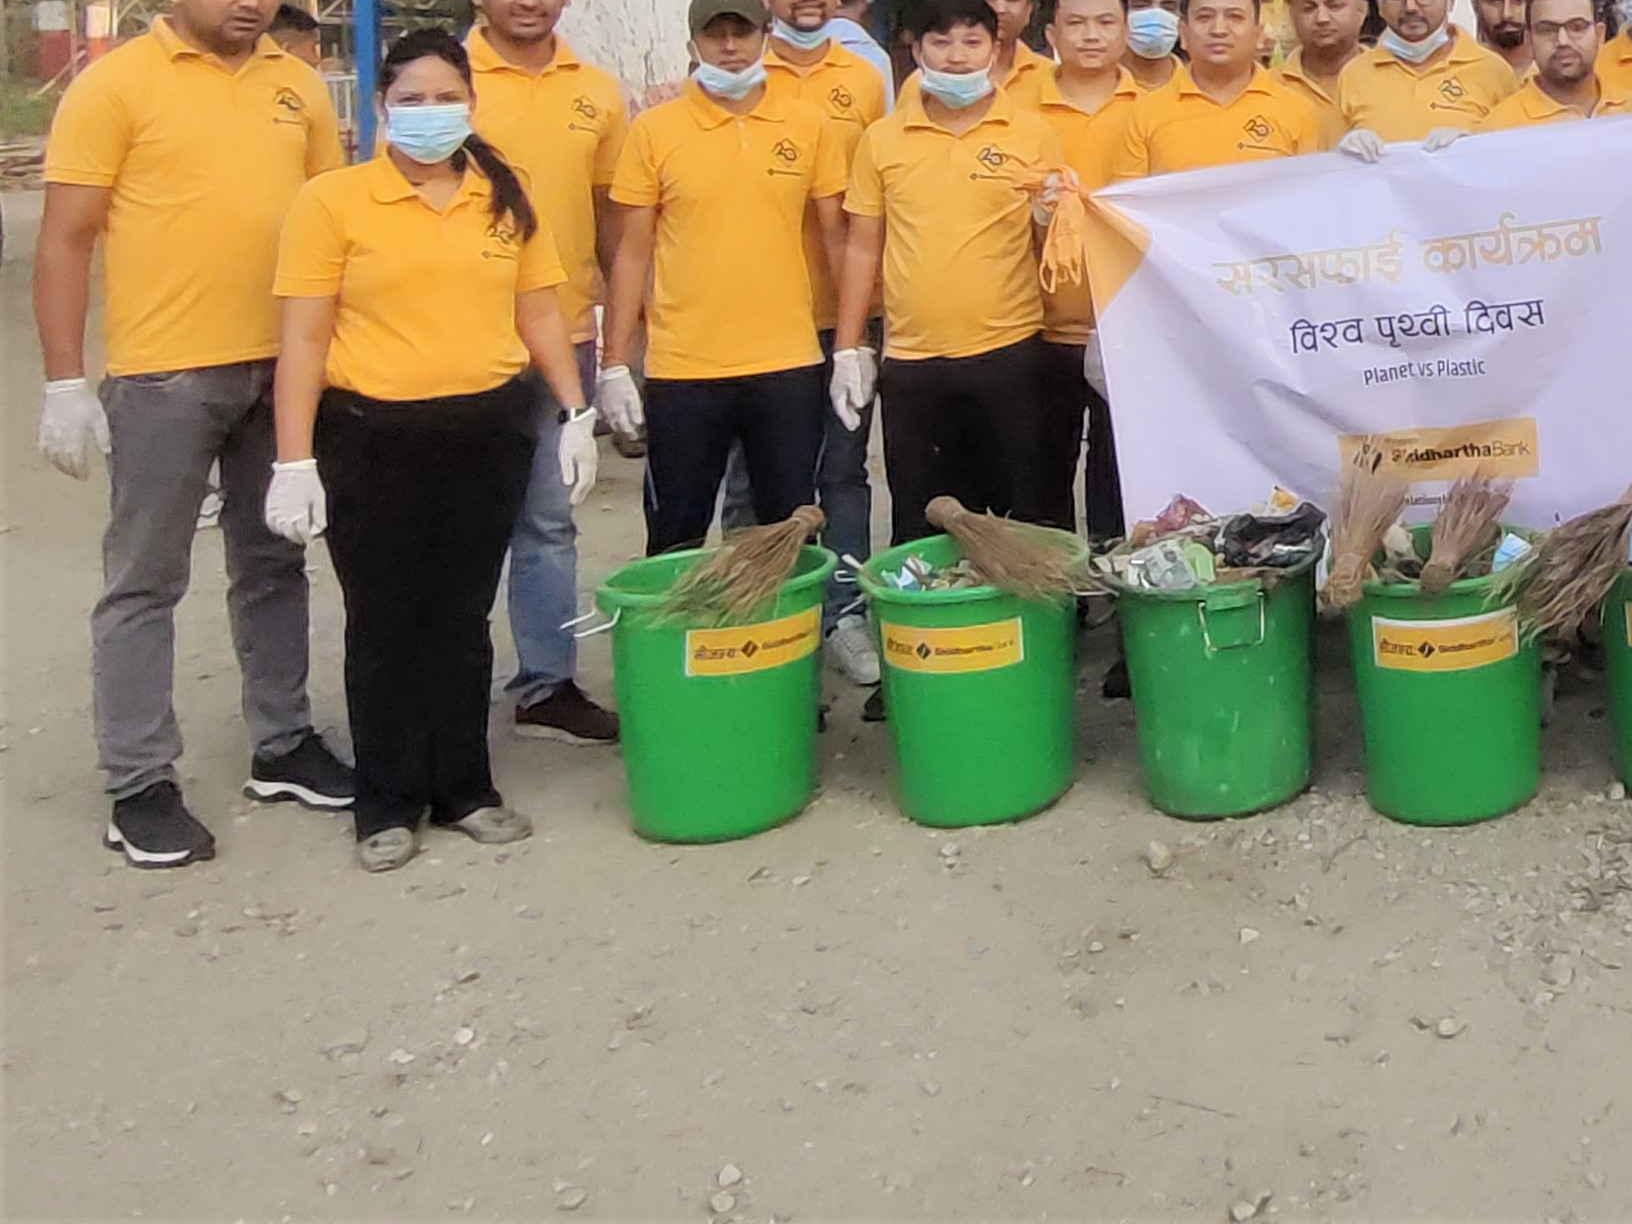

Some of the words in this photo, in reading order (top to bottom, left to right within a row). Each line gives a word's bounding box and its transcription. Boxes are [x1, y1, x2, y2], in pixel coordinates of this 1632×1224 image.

[1212, 227, 1406, 296] सरसफाई
[1421, 212, 1602, 274] कार्यक्रम
[1289, 317, 1364, 354] विश्व
[1375, 305, 1451, 349] पृथ्वी
[1464, 298, 1545, 335] दिवस
[1364, 361, 1415, 386] Planet
[1418, 364, 1434, 378] vs
[1437, 358, 1486, 378] Plastic
